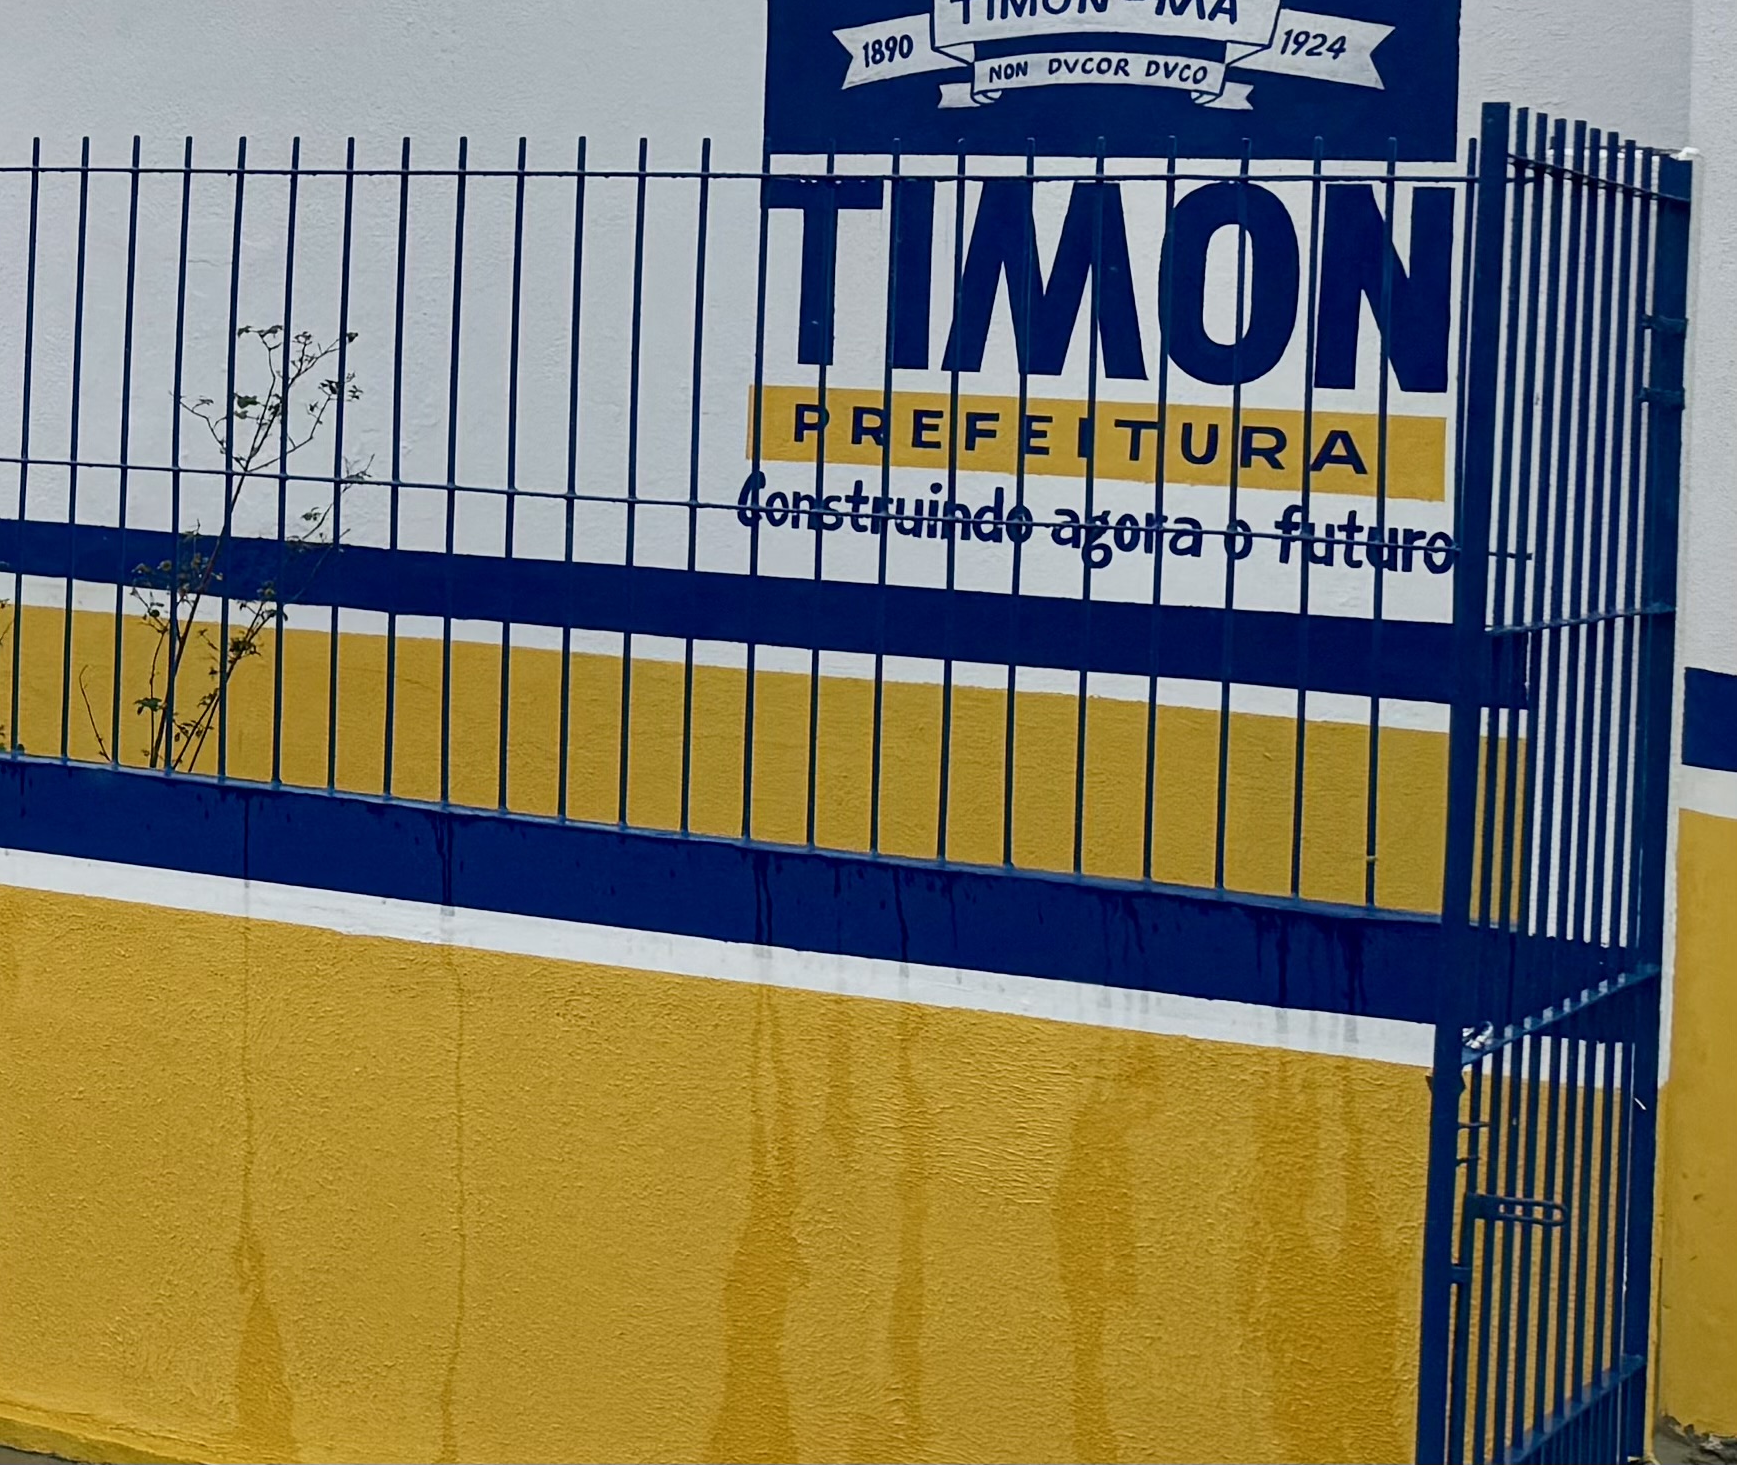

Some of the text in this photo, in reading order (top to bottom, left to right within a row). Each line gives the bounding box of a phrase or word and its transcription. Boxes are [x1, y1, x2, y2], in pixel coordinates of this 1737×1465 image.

[862, 34, 913, 68] 1890
[1279, 28, 1347, 60] 1924
[988, 57, 1208, 85] NON DVCOR DVCO
[761, 177, 1454, 393] TIMON
[794, 403, 1368, 475] PREFEITURA
[737, 470, 1455, 574] Construindo agora o futuro
